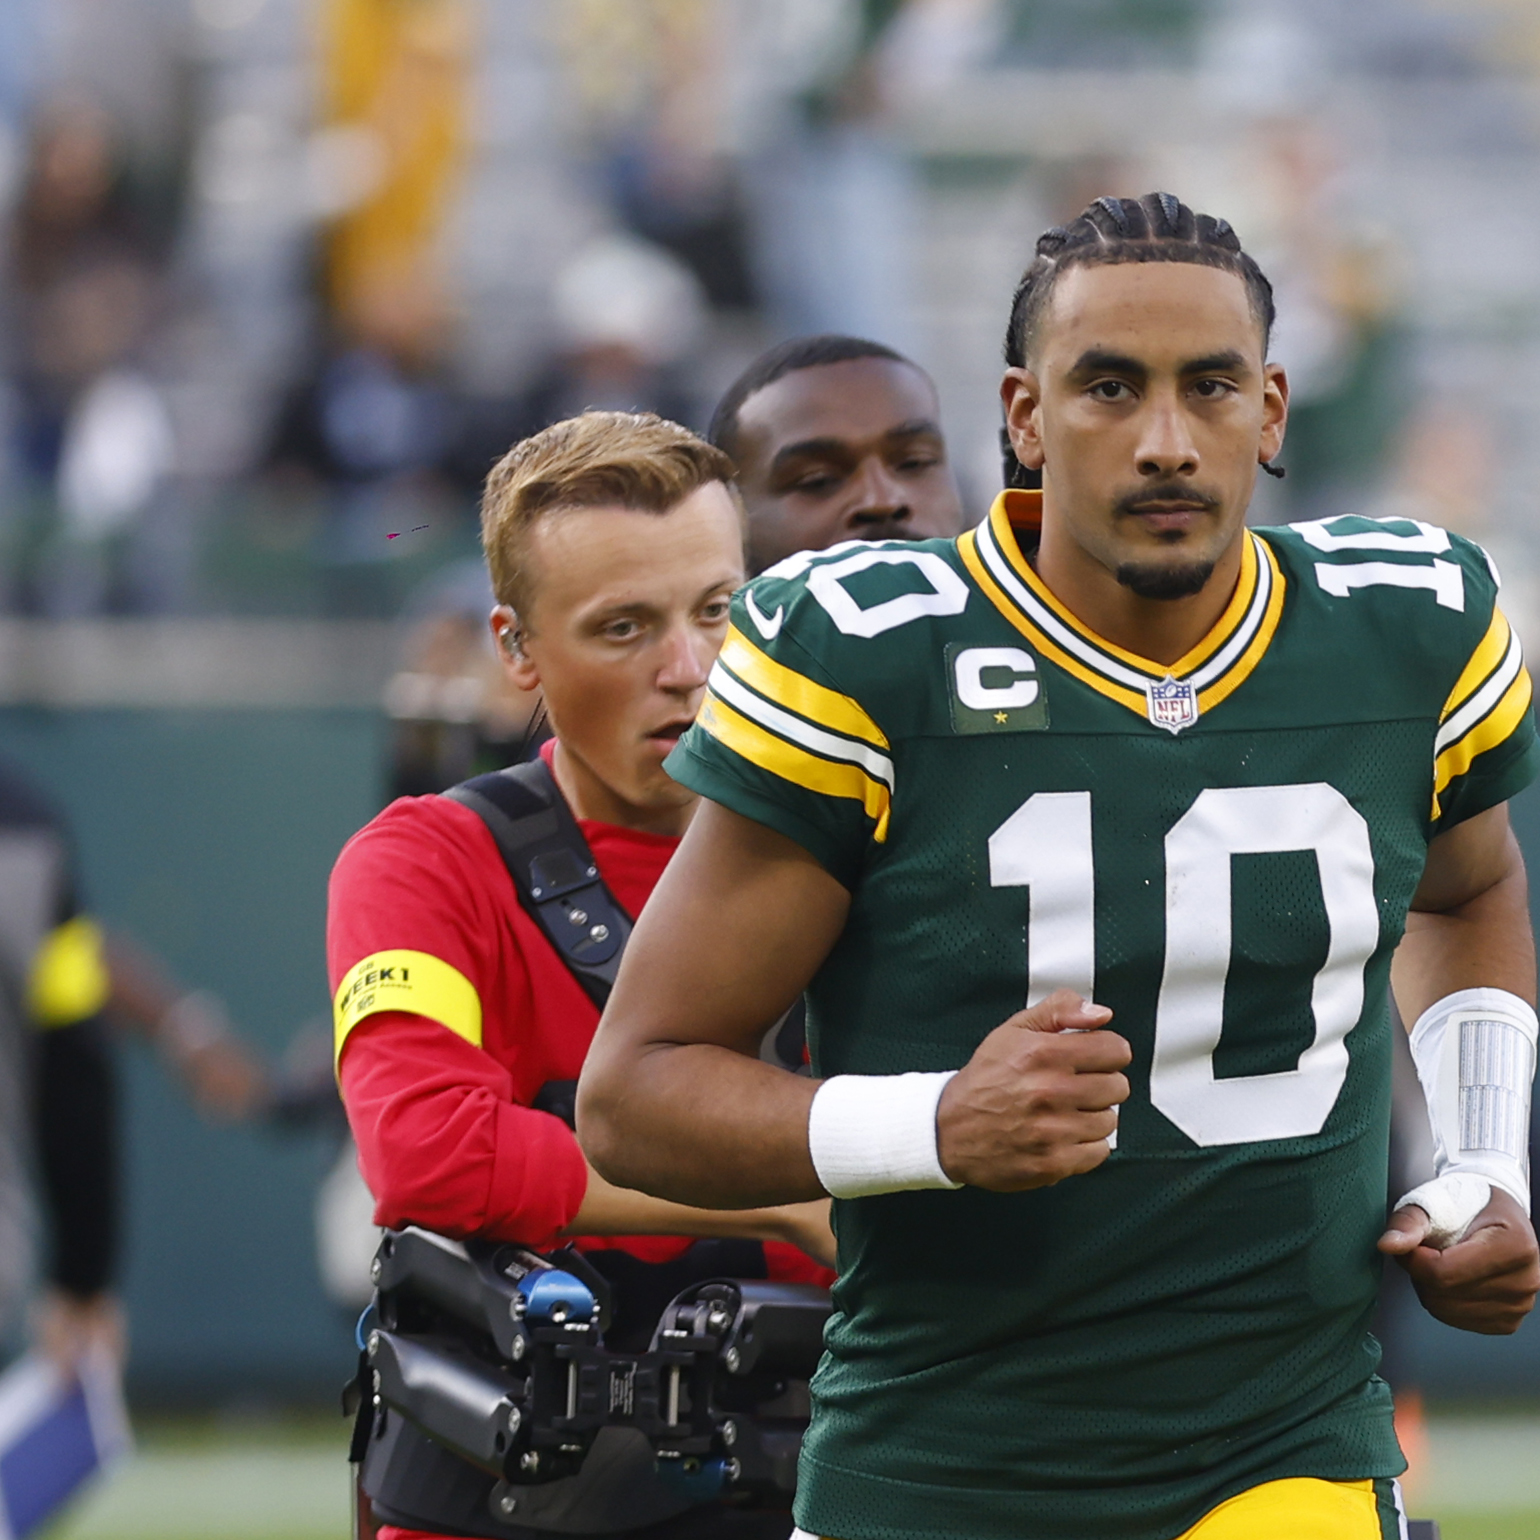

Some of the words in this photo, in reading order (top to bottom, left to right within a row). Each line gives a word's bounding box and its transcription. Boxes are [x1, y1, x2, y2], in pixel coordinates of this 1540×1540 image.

[955, 647, 1039, 710] C
[1157, 700, 1190, 722] NFL
[988, 782, 1380, 1148] 10
